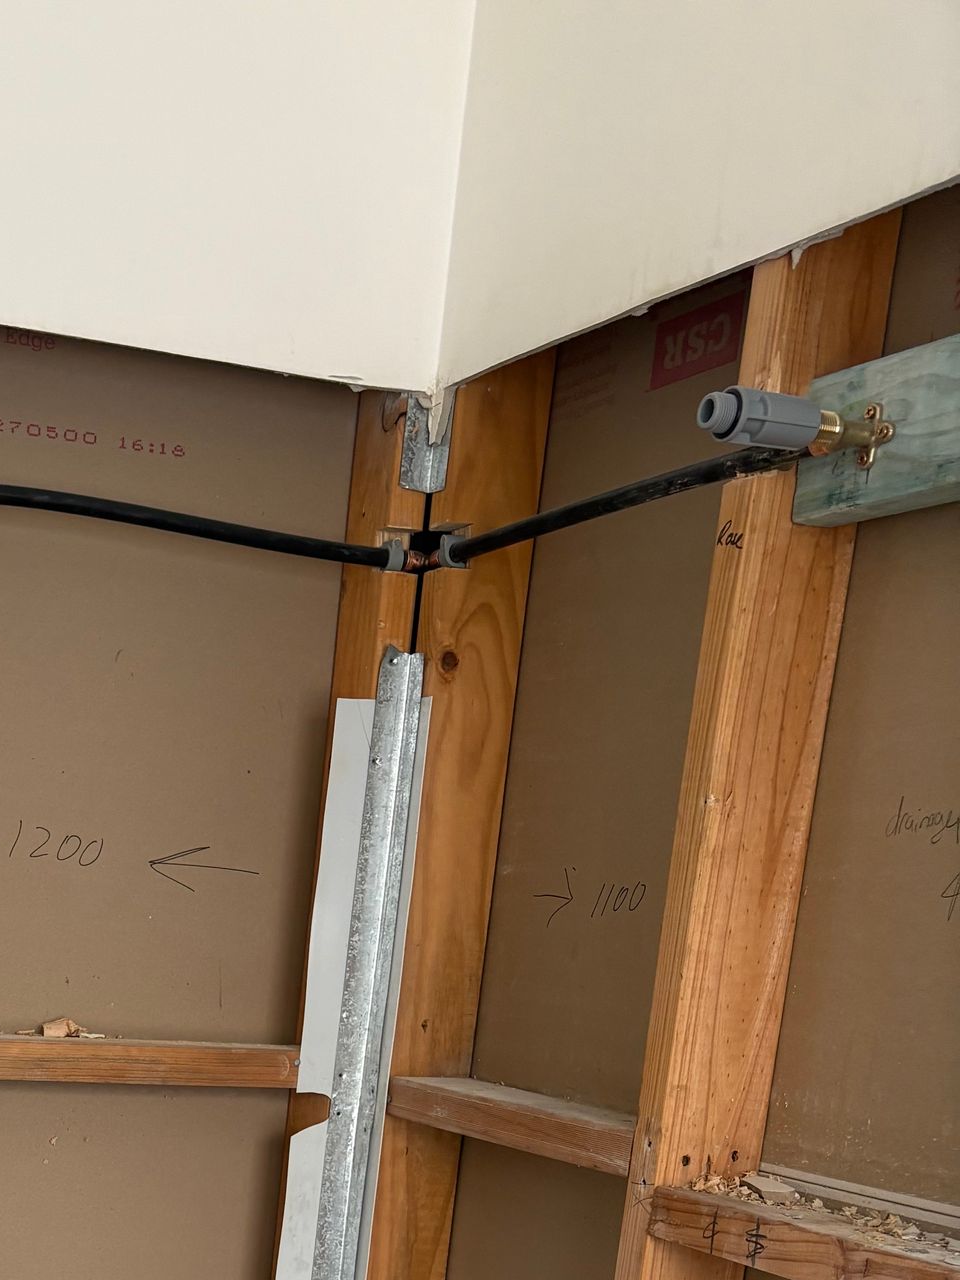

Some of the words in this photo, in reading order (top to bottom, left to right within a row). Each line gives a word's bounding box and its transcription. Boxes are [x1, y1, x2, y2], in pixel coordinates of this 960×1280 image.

[4, 326, 56, 351] Edge
[663, 311, 731, 370] CSR
[9, 819, 104, 866] 1200
[591, 881, 646, 918] 1100
